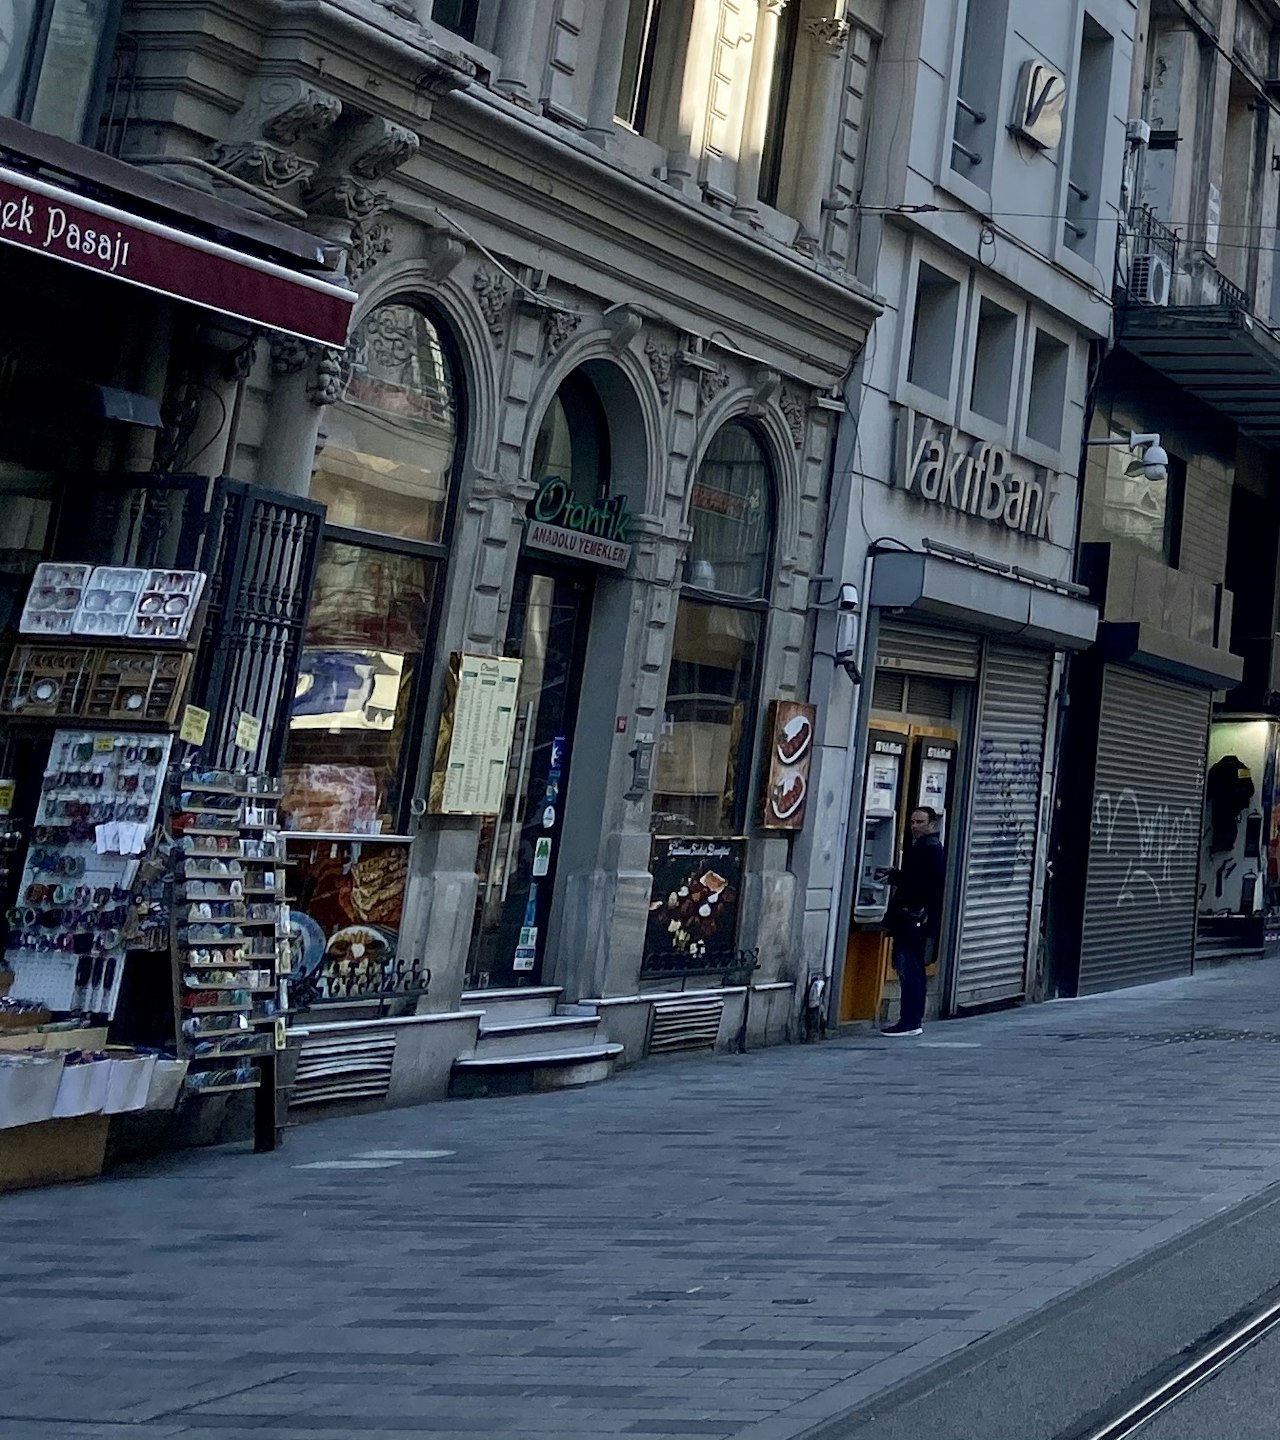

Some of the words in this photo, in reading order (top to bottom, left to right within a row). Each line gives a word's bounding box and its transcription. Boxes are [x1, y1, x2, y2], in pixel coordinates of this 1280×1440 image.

[0, 195, 34, 235] ek
[42, 206, 130, 272] Pasajı
[903, 409, 1062, 541] VakıfBank
[532, 526, 578, 552] ANADOLU
[535, 480, 631, 541] Otantik
